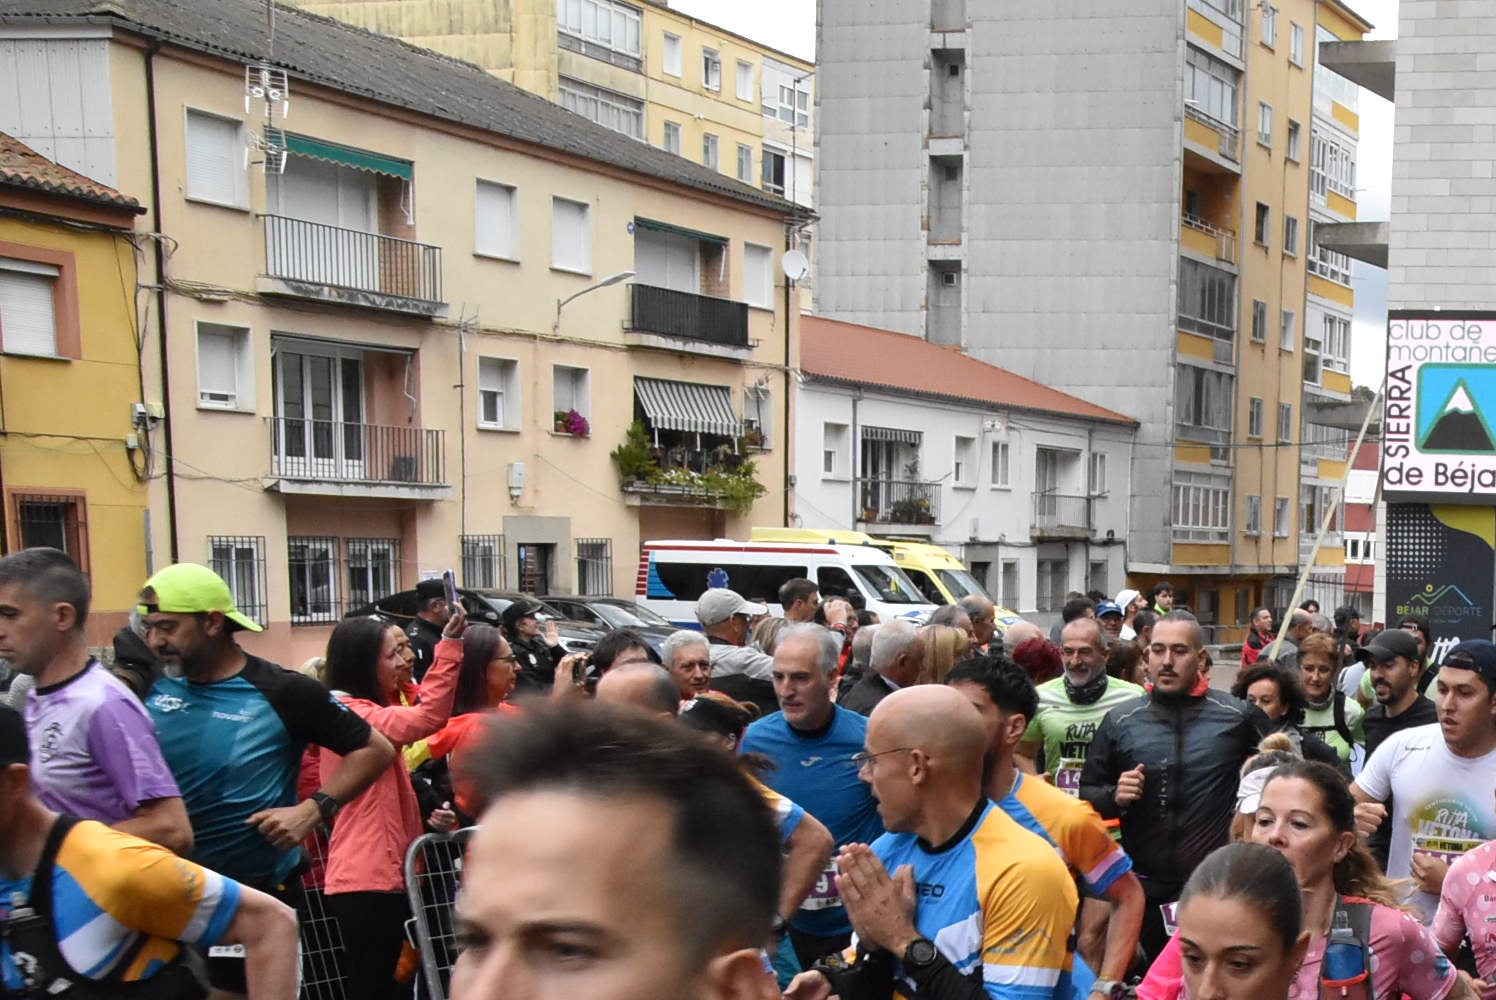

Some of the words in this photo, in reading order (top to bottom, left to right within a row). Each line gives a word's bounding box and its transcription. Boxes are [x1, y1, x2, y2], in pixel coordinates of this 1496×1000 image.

[1389, 321, 1442, 341] club
[1449, 322, 1483, 342] de
[1385, 364, 1414, 461] SIERRA
[1384, 462, 1424, 487] de
[1066, 722, 1097, 741] RUTA
[1434, 808, 1469, 829] RUTA
